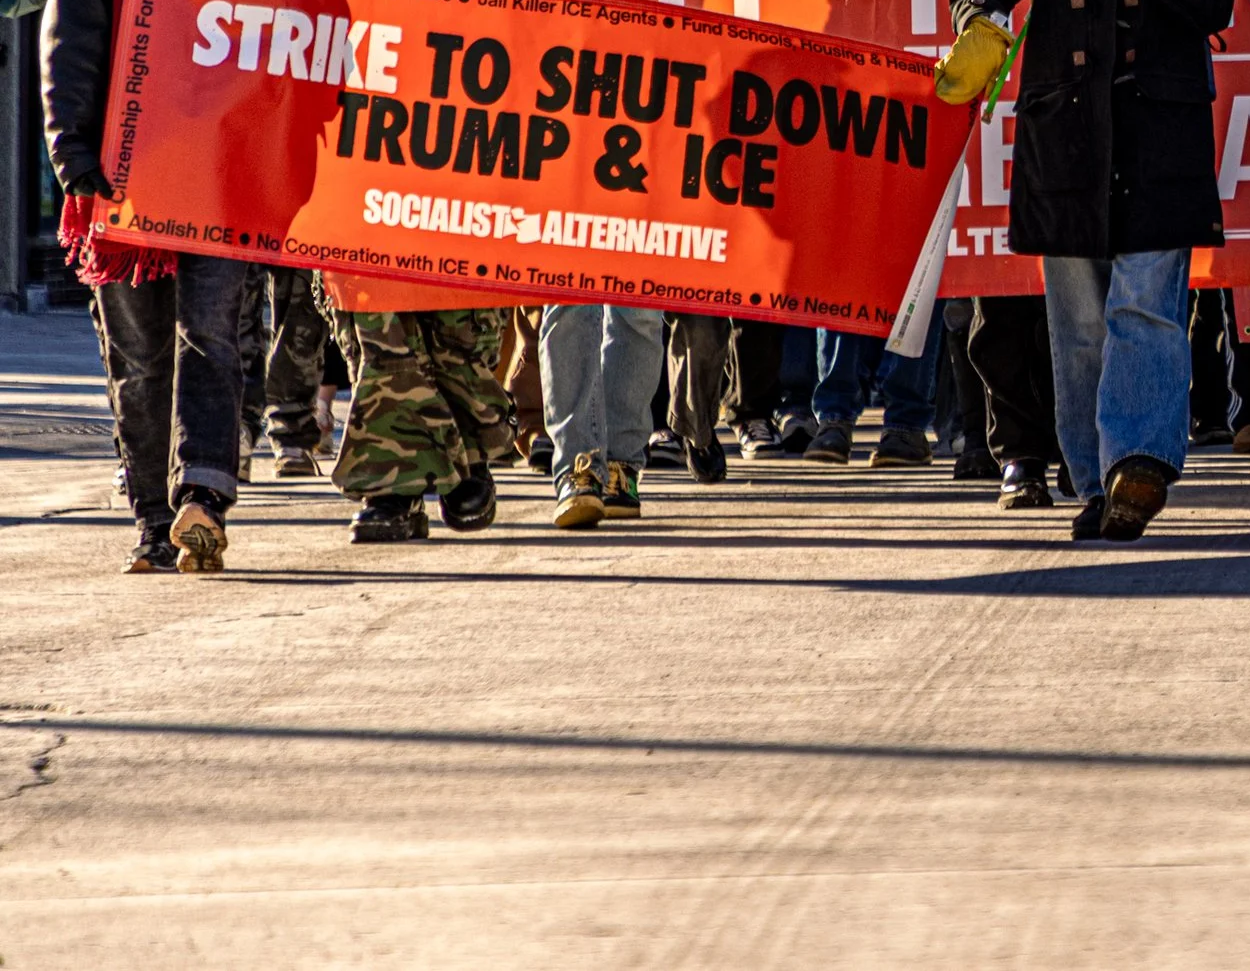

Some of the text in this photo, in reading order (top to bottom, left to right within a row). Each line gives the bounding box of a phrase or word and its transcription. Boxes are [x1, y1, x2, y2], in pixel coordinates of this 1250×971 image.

[135, 0, 154, 28] For
[561, 1, 591, 17] ICE
[596, 5, 657, 26] Agents
[682, 17, 723, 36] Fund
[727, 24, 797, 51] Schools,
[801, 39, 865, 66] Housing
[871, 52, 881, 66] &
[125, 34, 150, 95] Rights
[192, 0, 402, 94] STRIKE
[426, 31, 511, 106] TO
[535, 45, 706, 129] SHUT
[728, 69, 928, 169] DOWN
[111, 99, 143, 204] Citizenship
[335, 90, 778, 209] TRUMP & ICE
[128, 214, 197, 241] Abolish
[202, 225, 233, 244] ICE
[256, 233, 280, 251] No
[285, 238, 390, 266] Cooperation
[396, 253, 433, 272] with
[438, 257, 469, 275] ICE
[495, 264, 521, 281] No
[526, 267, 574, 287] Trust
[579, 273, 595, 290] In
[601, 275, 635, 294] The
[641, 280, 742, 305] Democrats
[769, 293, 799, 311] We
[803, 298, 851, 318] Need
[855, 305, 870, 320] A
[363, 187, 728, 263] SOCIALIST ALTERNATIVE
